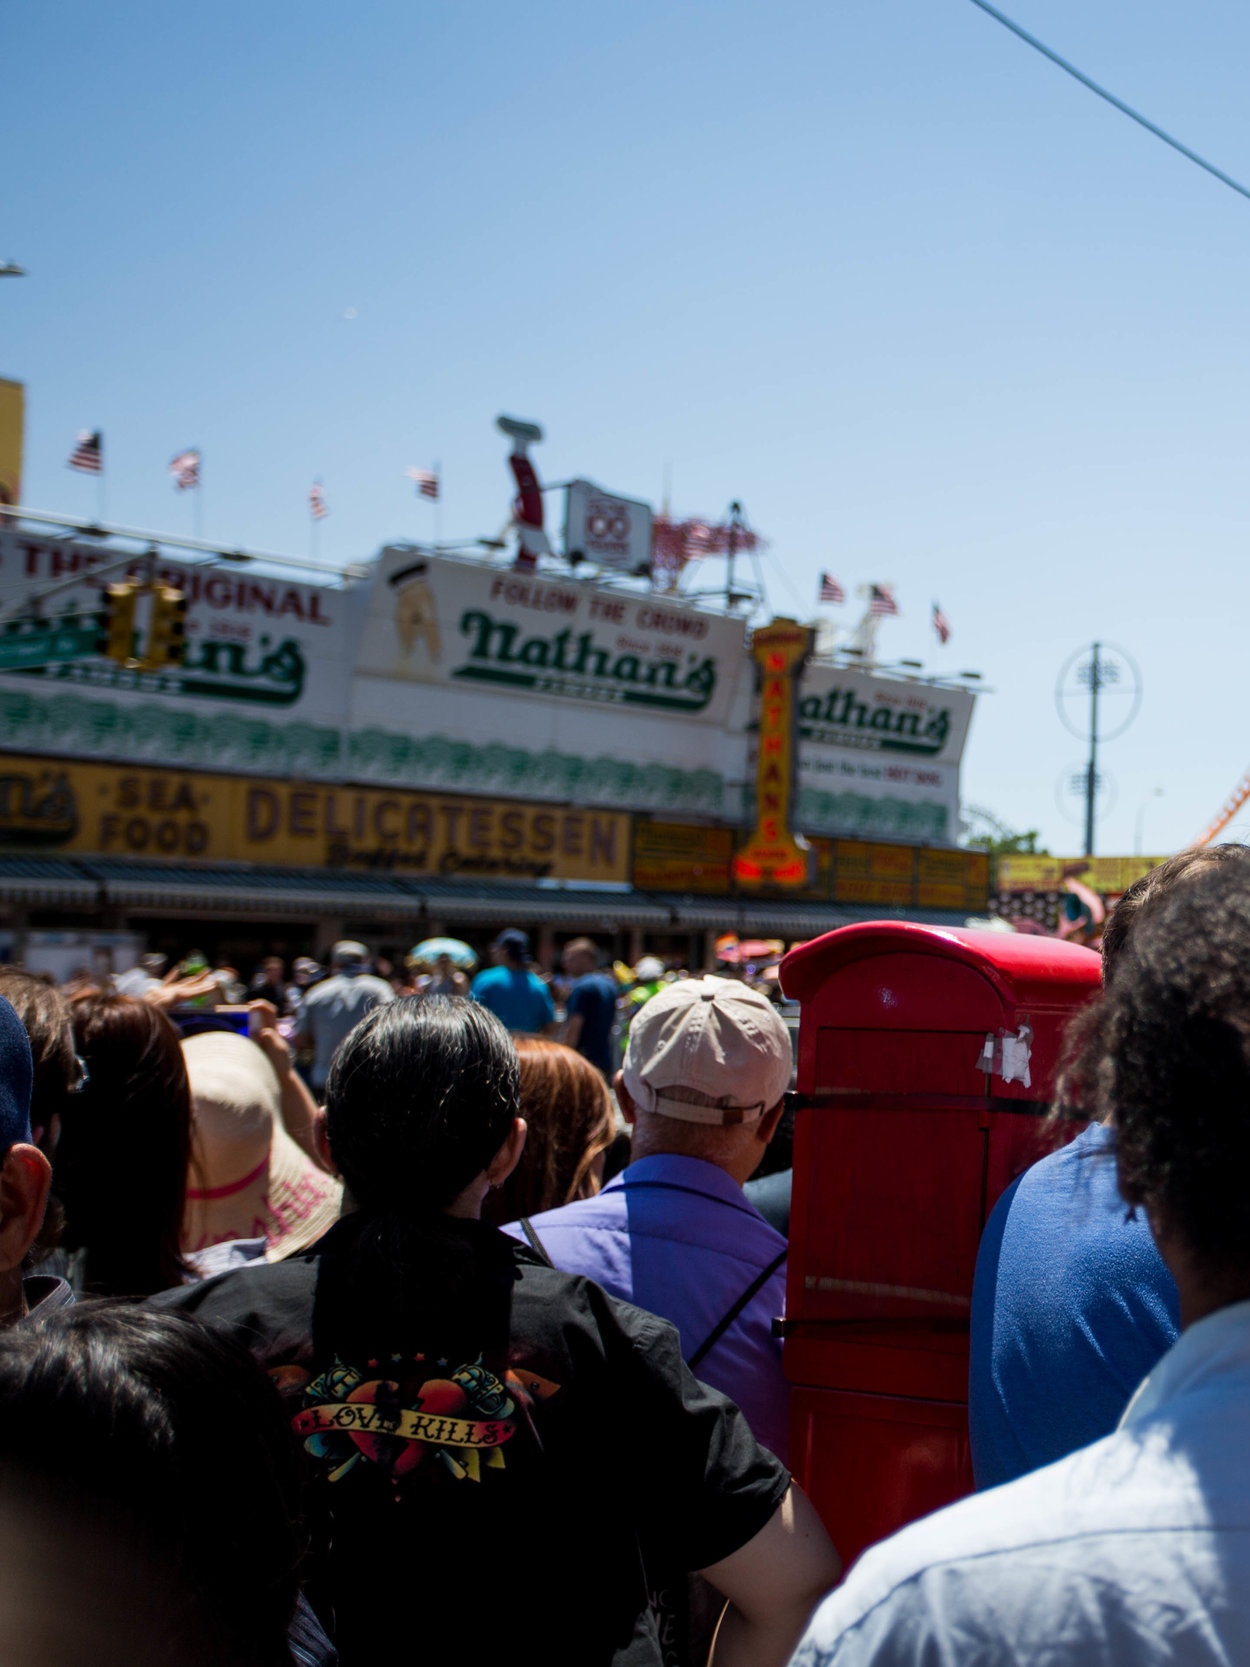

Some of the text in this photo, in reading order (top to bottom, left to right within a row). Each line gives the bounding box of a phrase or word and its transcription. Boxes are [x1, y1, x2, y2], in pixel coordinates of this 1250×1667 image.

[490, 579, 710, 641] FOLLOW THE CROWD
[459, 609, 718, 694] Nathan's
[799, 683, 951, 738] athan's
[117, 776, 196, 811] SEA
[99, 814, 209, 851] FOOD
[246, 787, 619, 866] DELICATESSEN
[312, 1404, 499, 1446] LOVE KILLS
